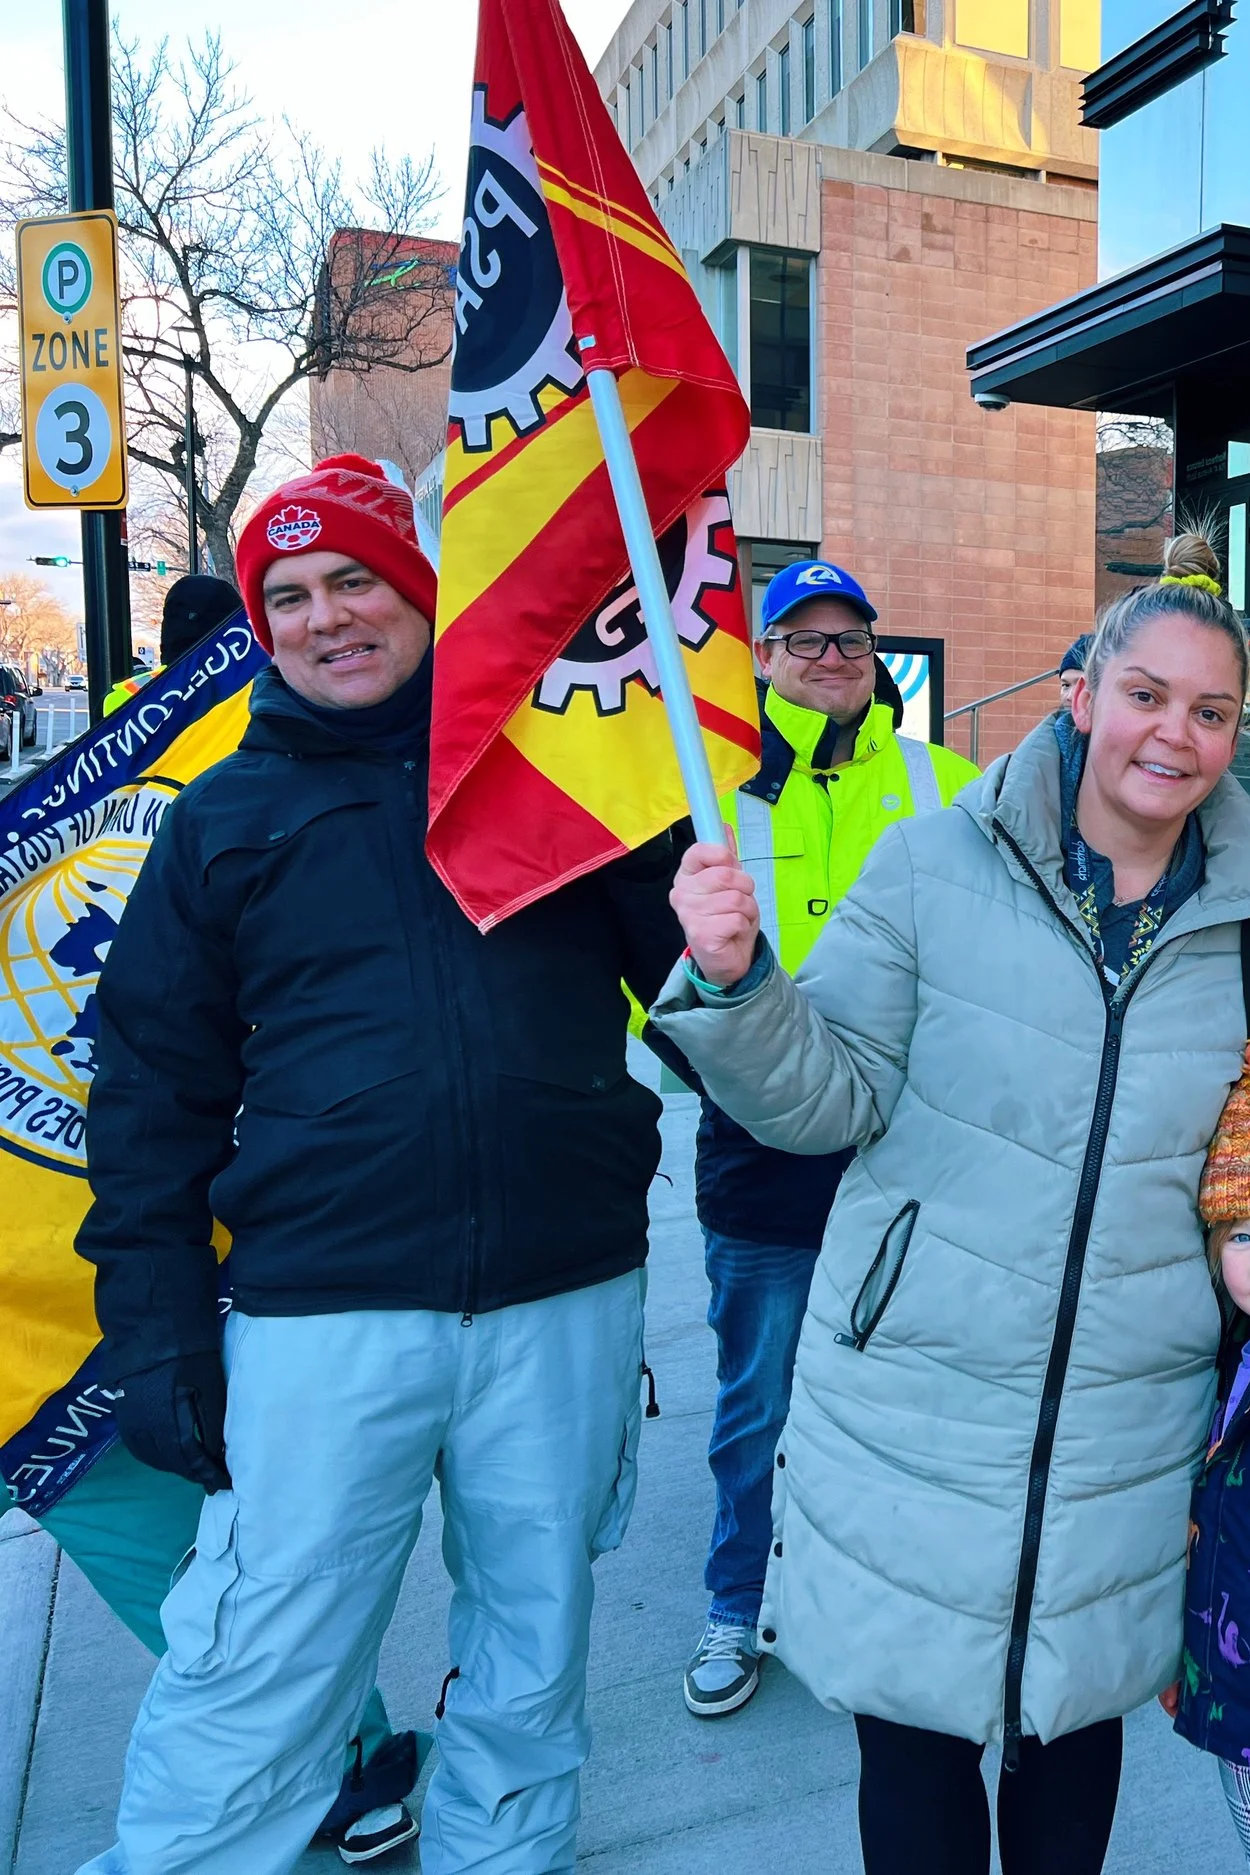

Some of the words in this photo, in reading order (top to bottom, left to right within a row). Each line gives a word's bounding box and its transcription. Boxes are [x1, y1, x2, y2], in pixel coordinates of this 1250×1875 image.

[58, 260, 79, 300] P
[32, 328, 110, 373] ZONE
[54, 400, 93, 476] 3
[269, 521, 320, 536] CANADA
